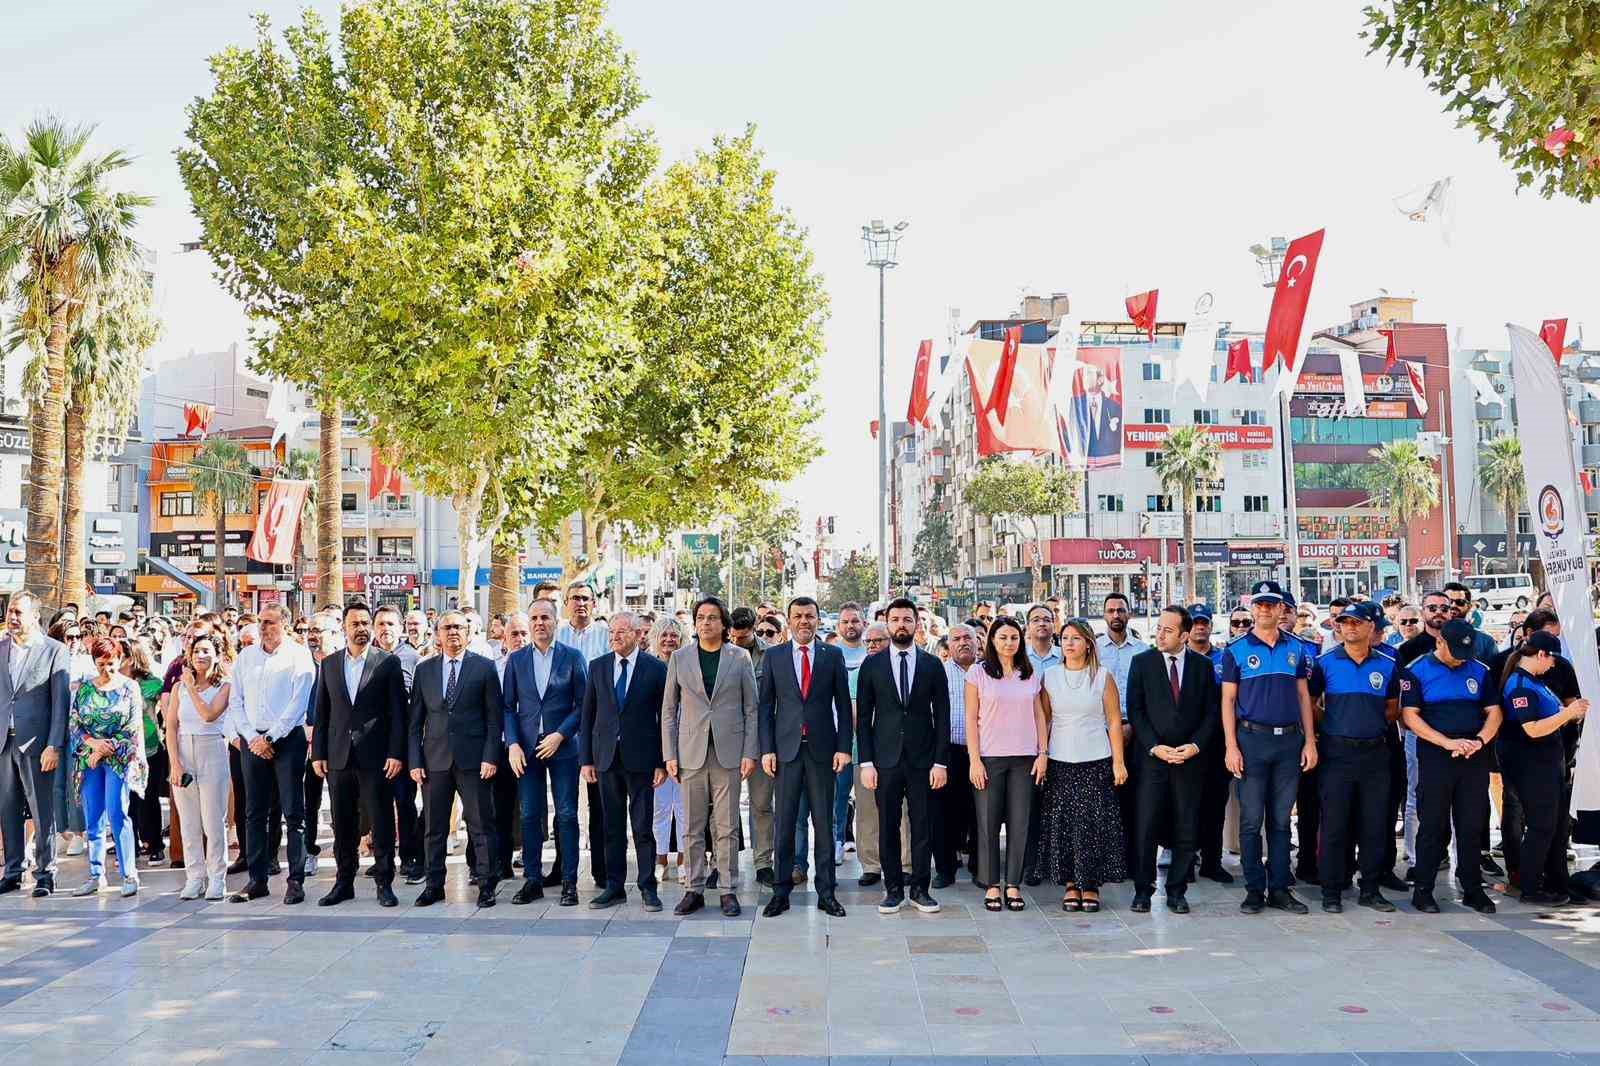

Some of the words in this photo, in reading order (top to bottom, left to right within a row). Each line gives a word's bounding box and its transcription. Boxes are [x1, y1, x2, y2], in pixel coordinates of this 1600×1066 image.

[1098, 550, 1137, 560] TUDORS
[1351, 545, 1380, 556] KING
[364, 574, 407, 586] DOĞUŞ
